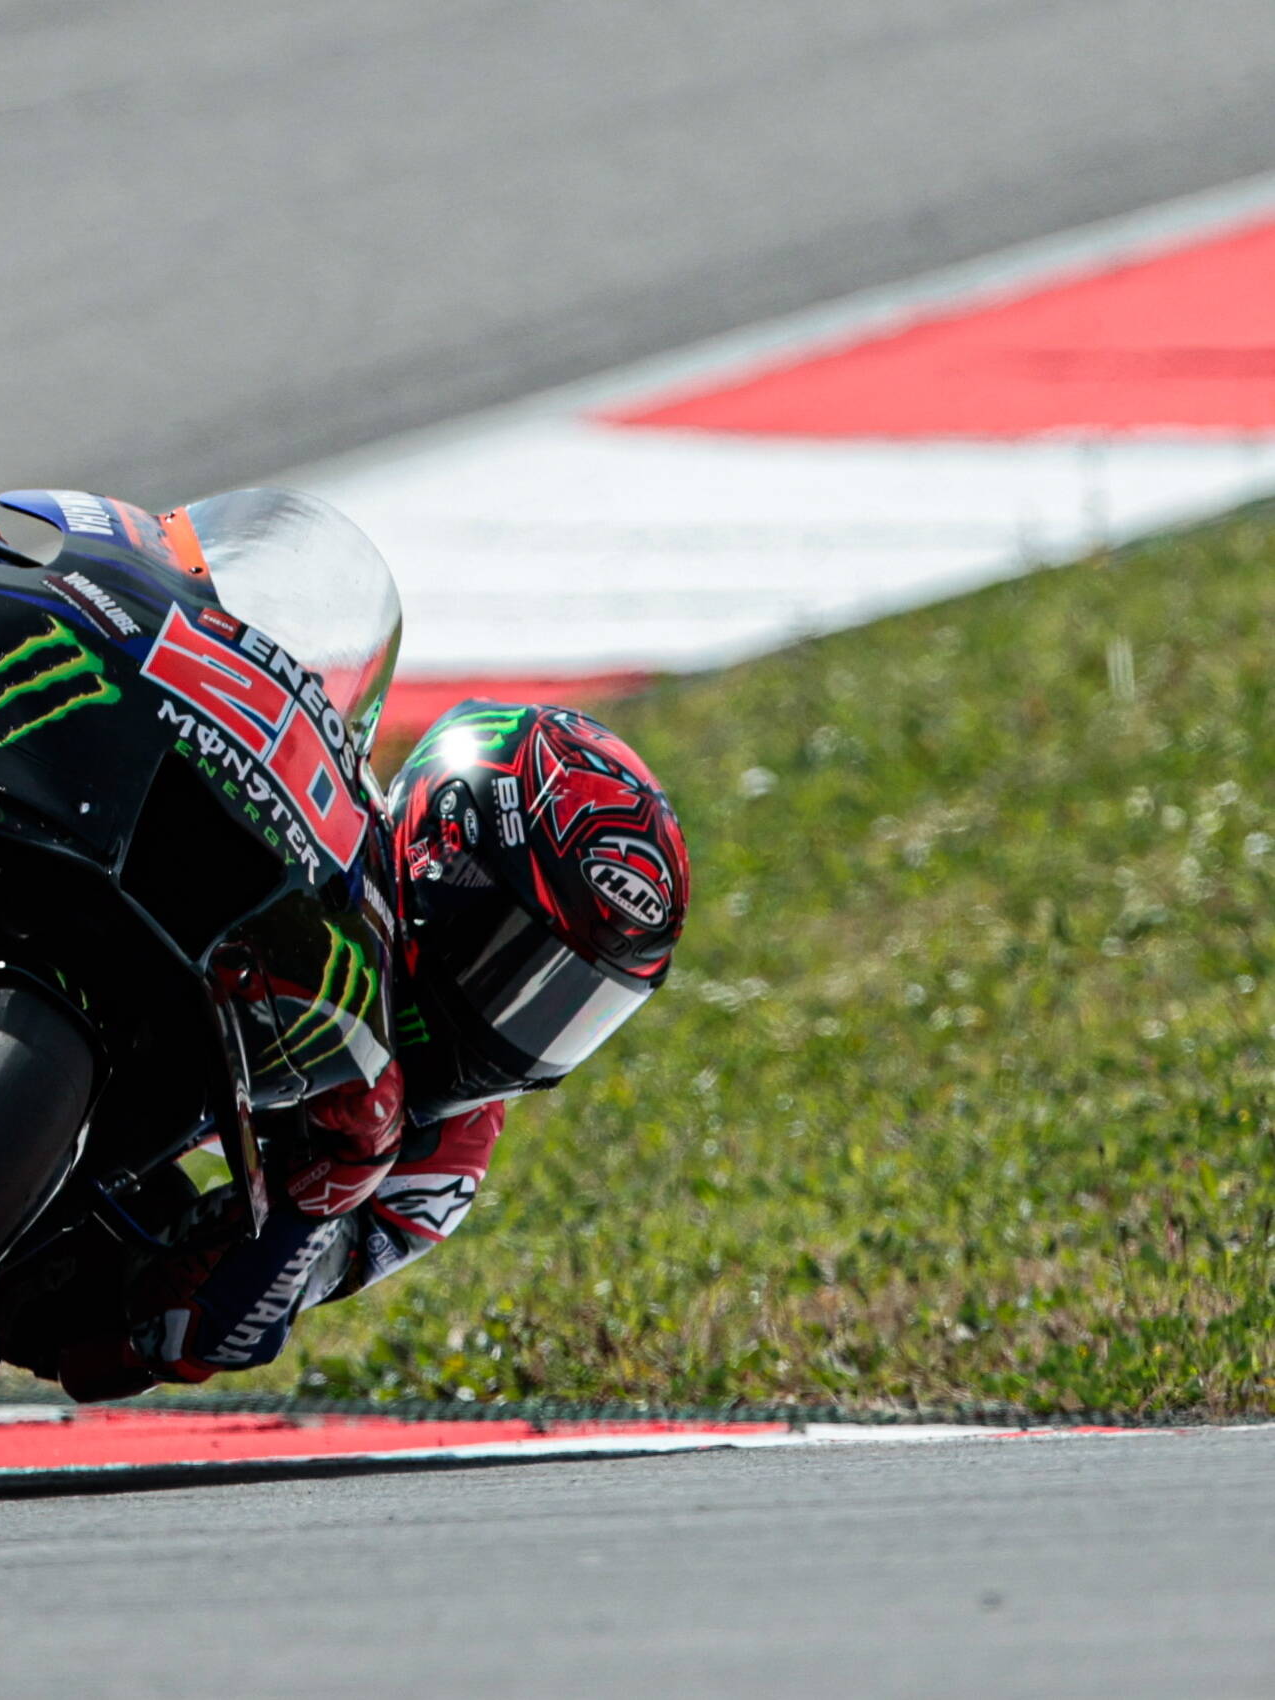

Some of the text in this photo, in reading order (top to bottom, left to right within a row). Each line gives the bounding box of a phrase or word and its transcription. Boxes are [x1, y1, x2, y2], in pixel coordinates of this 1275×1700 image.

[63, 571, 141, 635] YAMALUBE
[140, 601, 368, 873] 20
[239, 626, 357, 780] ENEOS
[157, 699, 320, 885] MONSTER
[173, 738, 296, 865] ENERGY
[496, 776, 526, 847] BS
[593, 867, 662, 922] HJC
